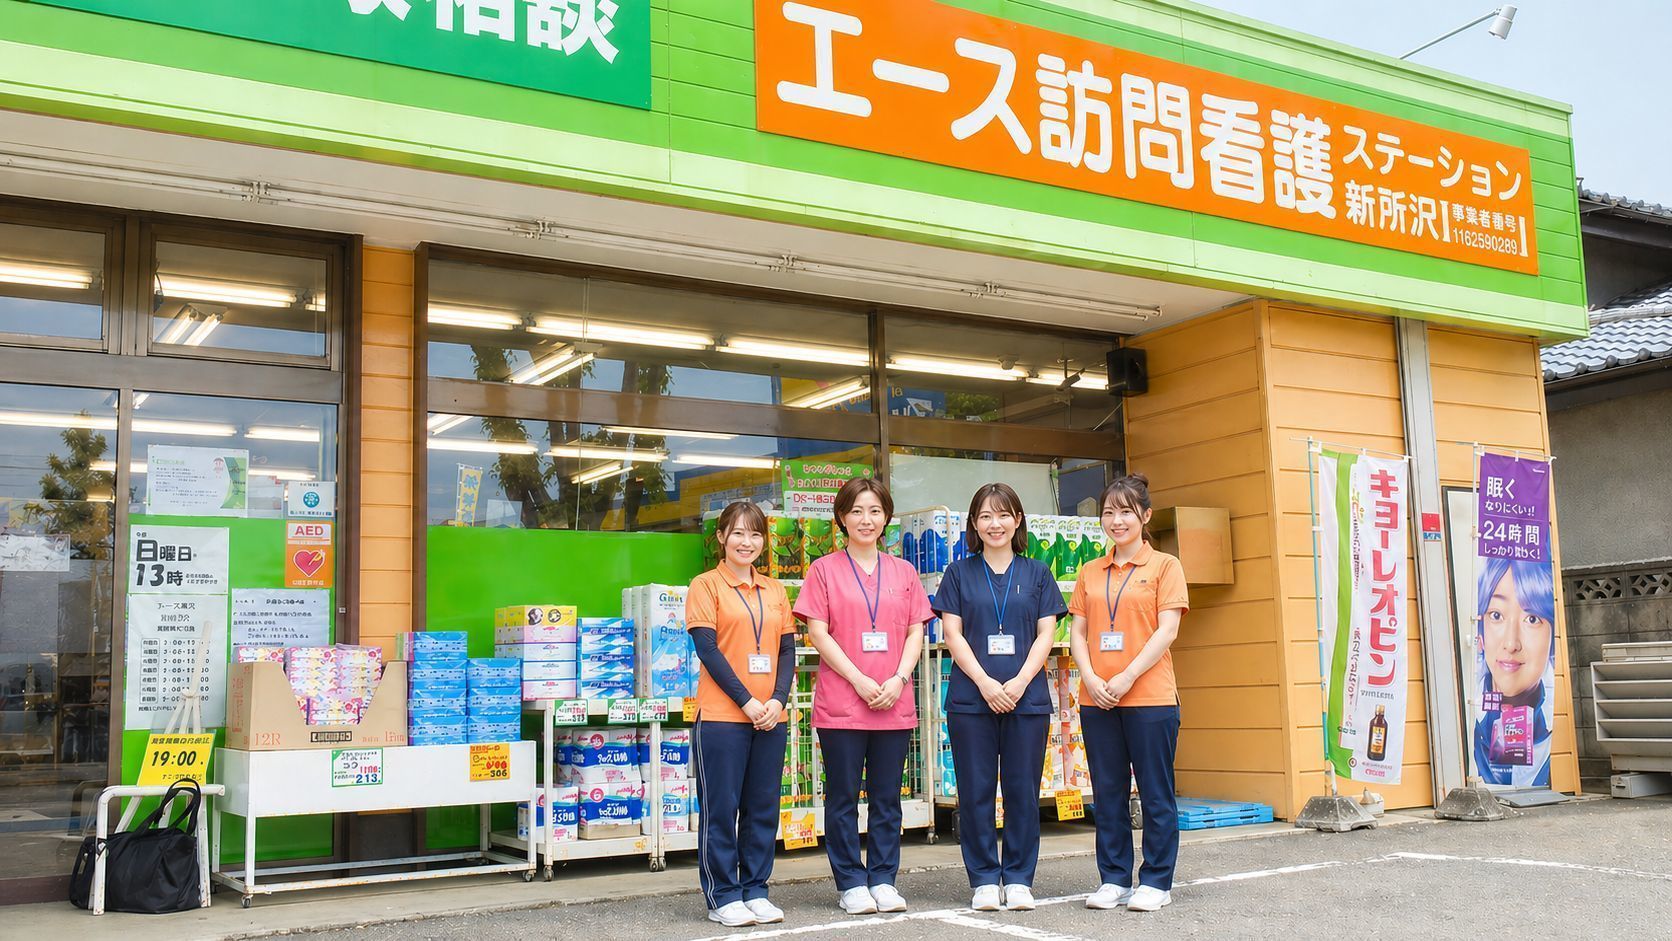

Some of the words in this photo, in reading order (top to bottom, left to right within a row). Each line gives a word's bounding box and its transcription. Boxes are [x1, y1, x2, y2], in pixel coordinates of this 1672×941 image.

[777, 1, 1336, 220] エース訪問看護
[1343, 124, 1522, 200] ステーション
[1486, 476, 1515, 500] 眠く
[295, 525, 324, 536] AED
[1483, 520, 1540, 545] 24時間
[136, 539, 192, 561] 日曜日
[136, 563, 183, 586] 13時
[254, 732, 281, 746] 12R
[151, 750, 197, 766] 19:00
